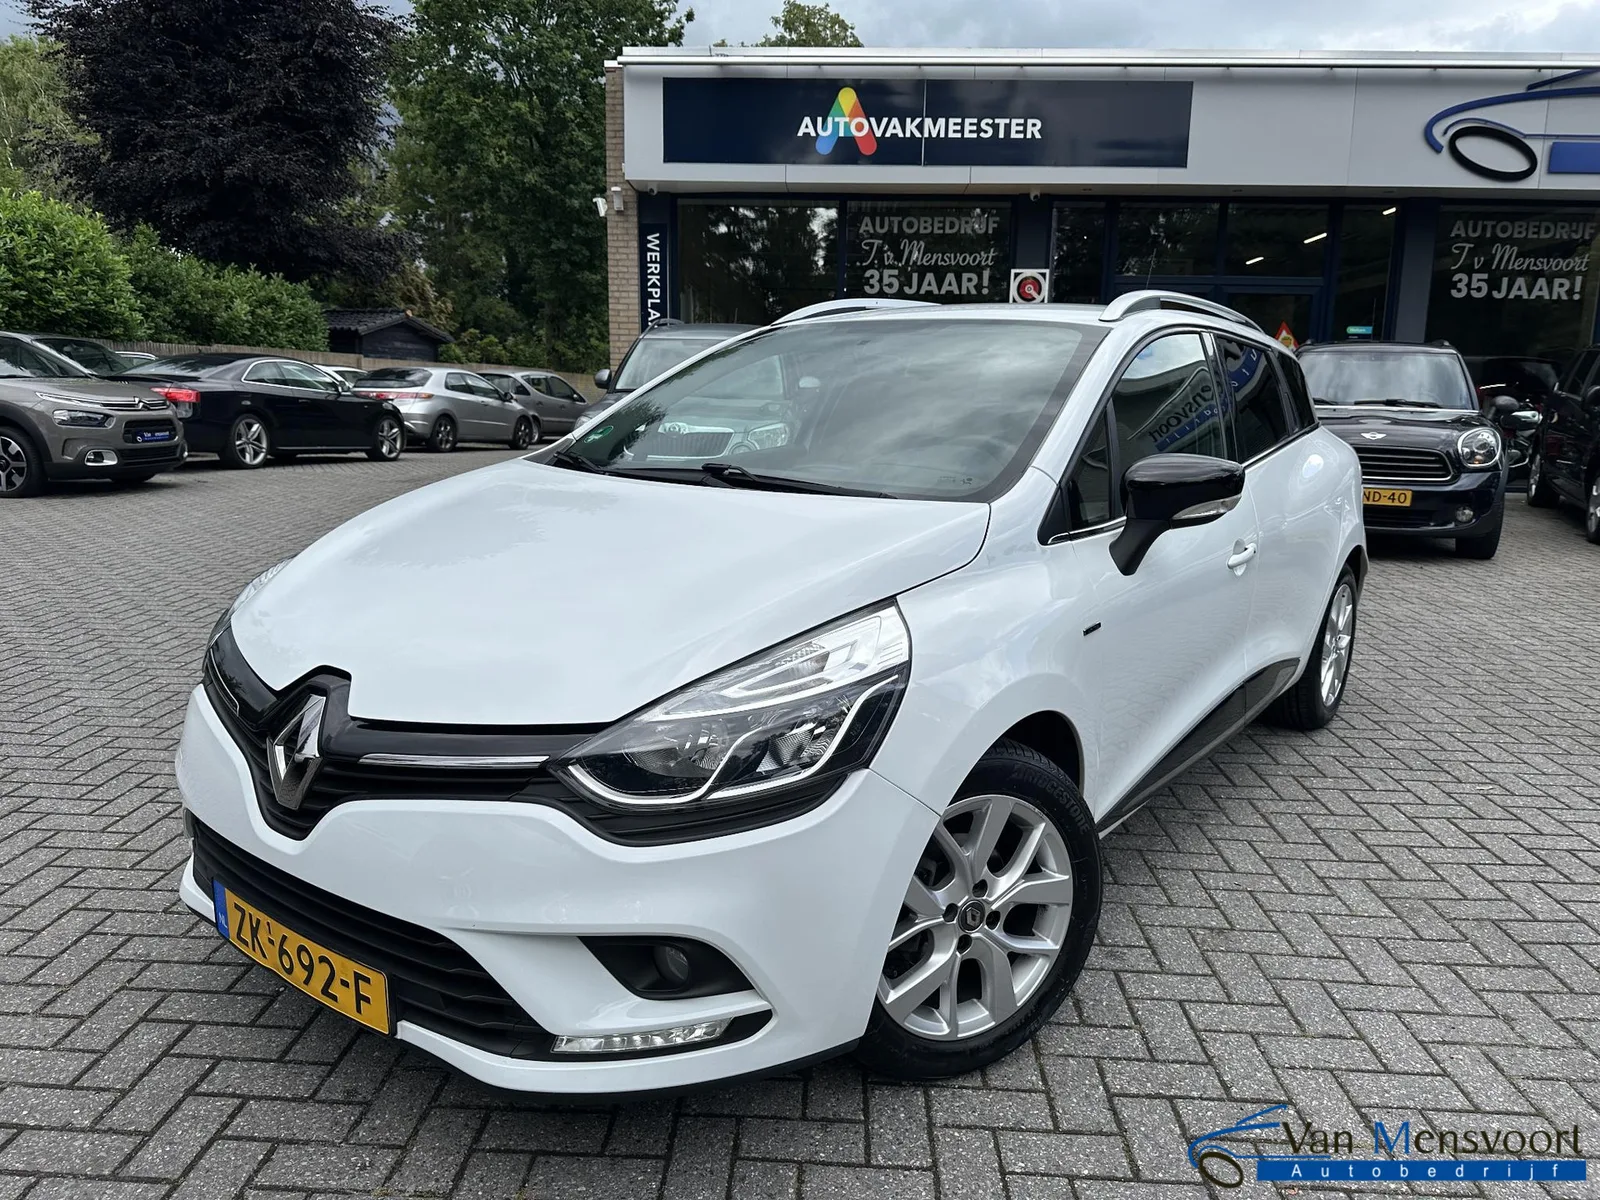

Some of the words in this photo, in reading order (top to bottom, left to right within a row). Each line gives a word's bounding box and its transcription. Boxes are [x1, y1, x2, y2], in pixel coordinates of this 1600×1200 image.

[796, 116, 1043, 140] AUTOVAKMEESTER
[858, 216, 1000, 235] AUTOBEDRIJF
[1450, 219, 1597, 240] AUTOBEDRIJF
[899, 238, 999, 267] Mensvoort
[1491, 242, 1590, 272] Mensvoort
[645, 232, 662, 327] WERKPLA
[863, 268, 899, 295] 35
[903, 268, 990, 296] JAAR!
[1450, 272, 1489, 299] 35
[1491, 275, 1583, 300] JAAR!
[233, 901, 372, 1015] ZK-692-F
